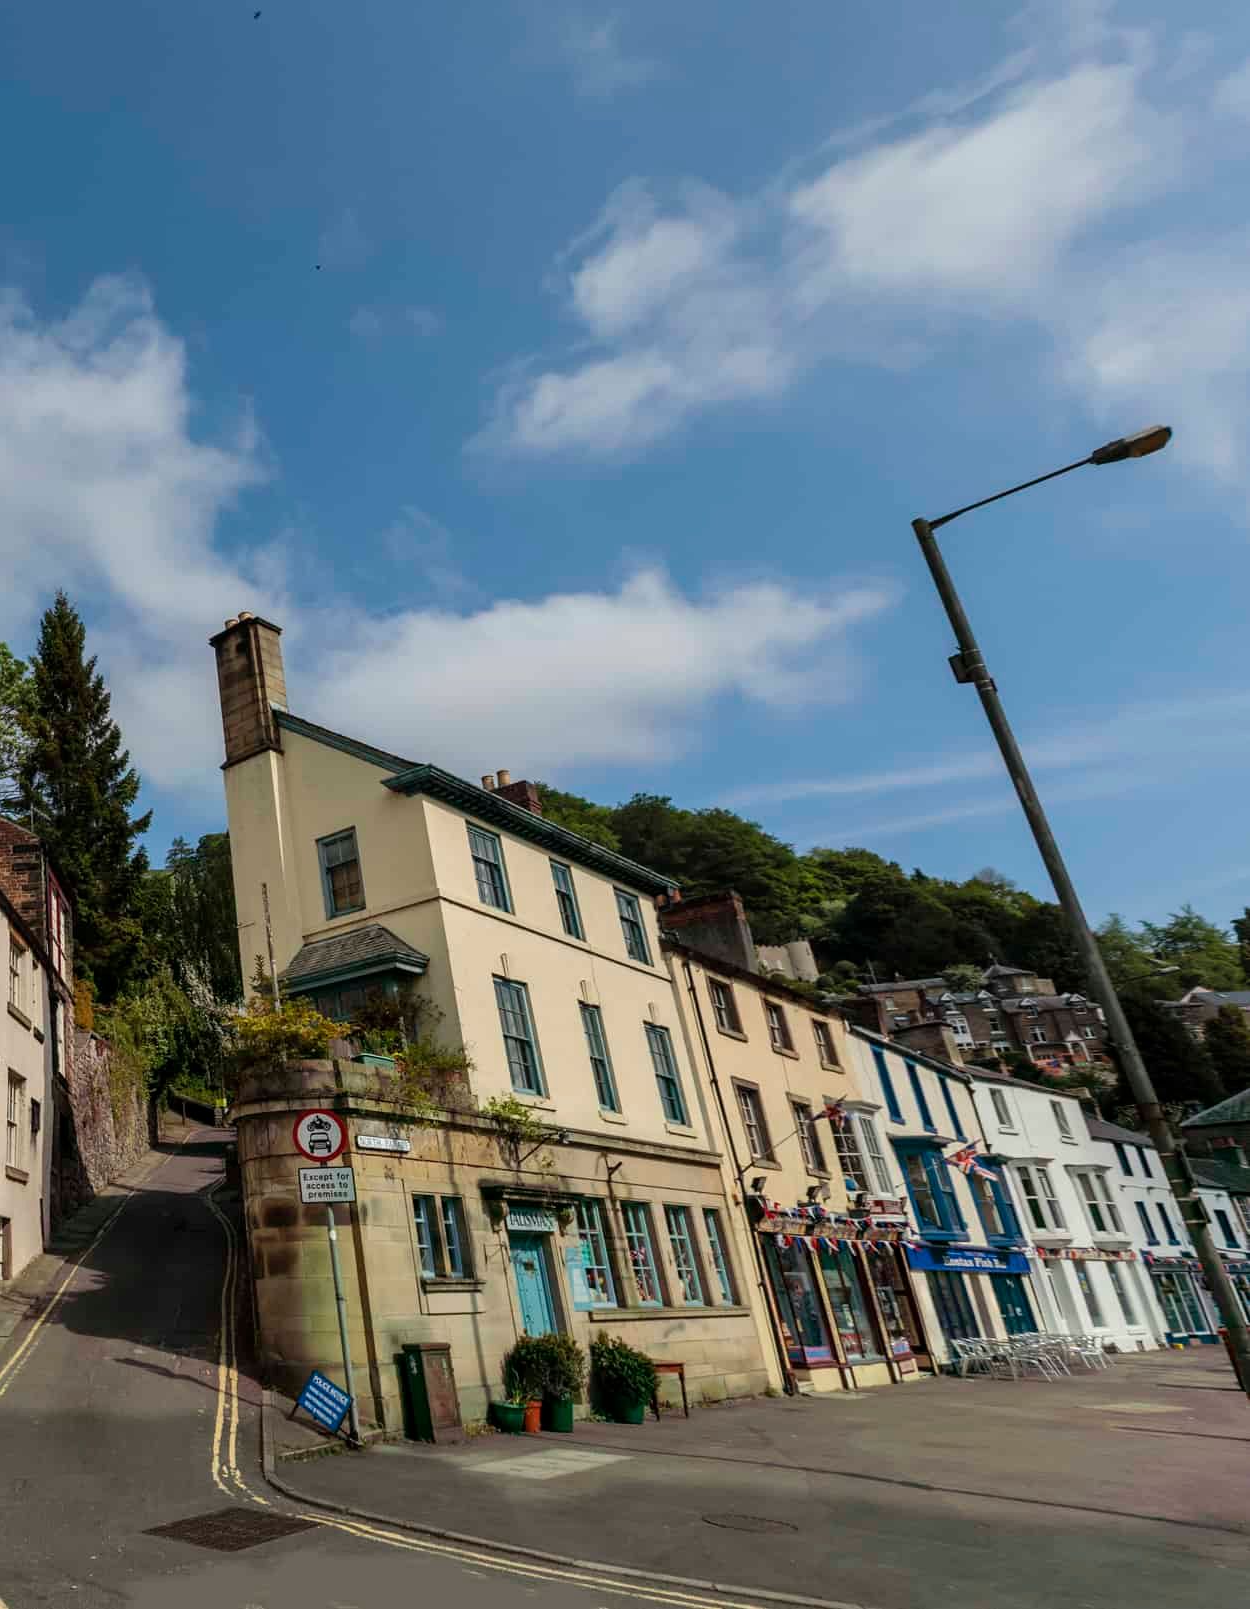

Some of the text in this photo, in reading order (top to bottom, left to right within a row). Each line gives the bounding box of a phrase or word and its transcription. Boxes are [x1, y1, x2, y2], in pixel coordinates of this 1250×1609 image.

[303, 1172, 349, 1181] Except for
[308, 1190, 348, 1199] premises
